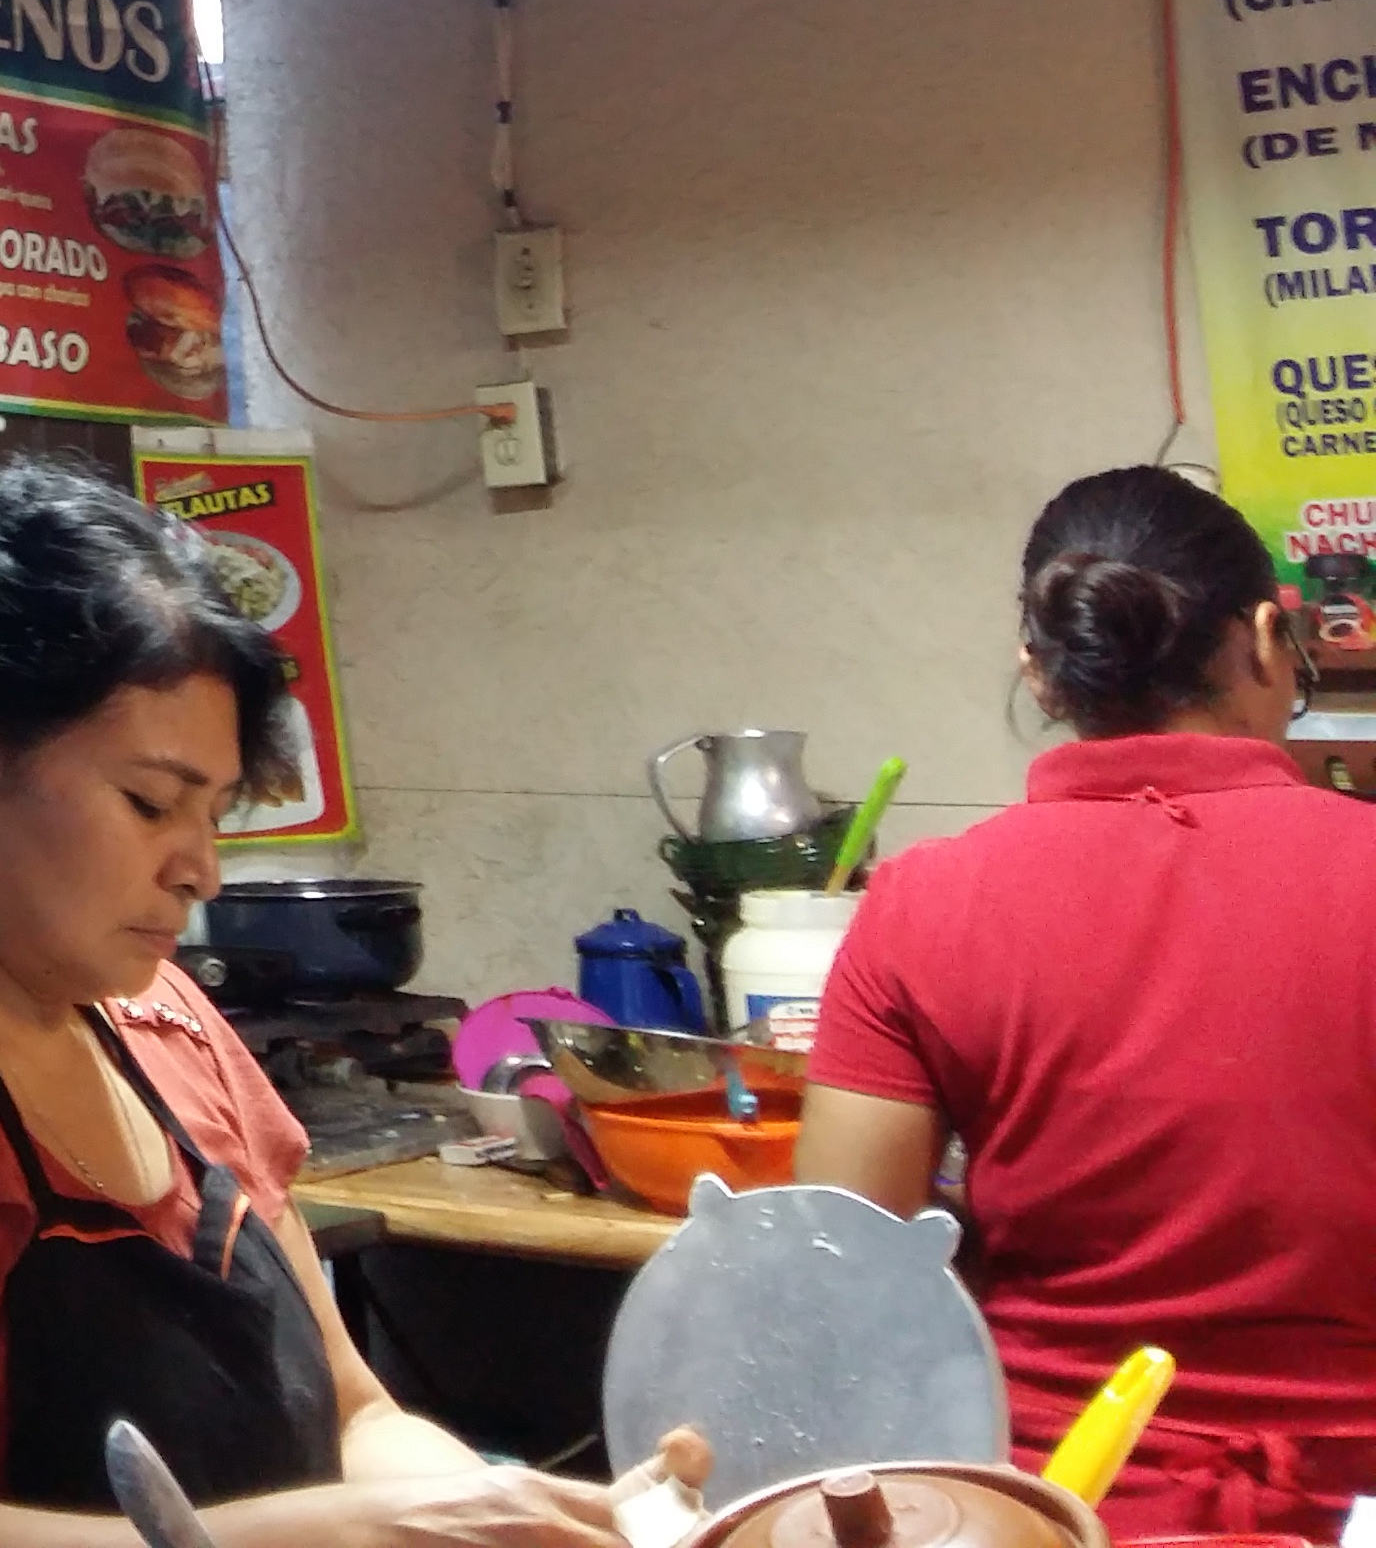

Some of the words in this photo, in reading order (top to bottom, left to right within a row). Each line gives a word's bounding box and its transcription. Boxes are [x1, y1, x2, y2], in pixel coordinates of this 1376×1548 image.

[1243, 127, 1340, 170] (DE
[1254, 207, 1376, 258] TOR
[1273, 353, 1376, 399] QUE
[1282, 431, 1376, 458] CARNE
[1305, 501, 1374, 528] CHU
